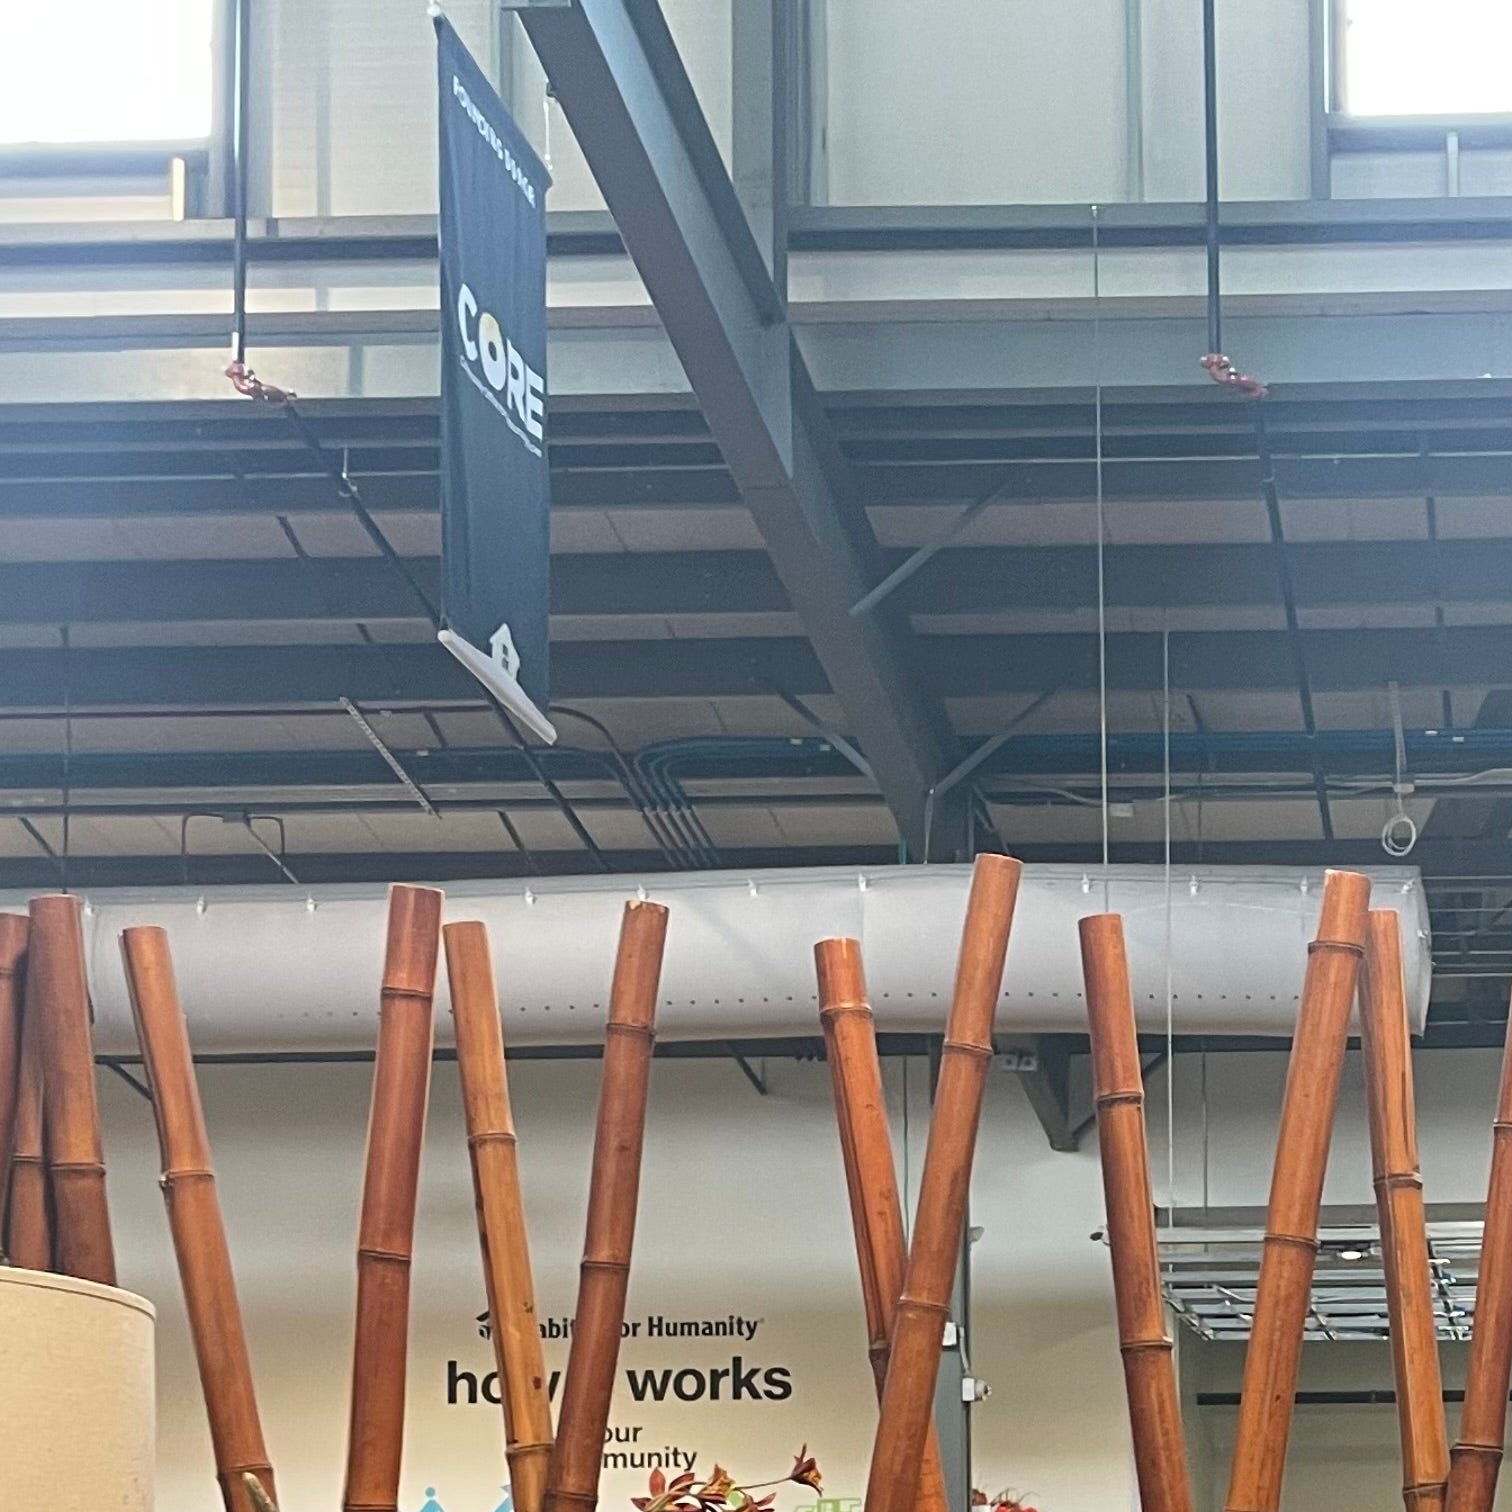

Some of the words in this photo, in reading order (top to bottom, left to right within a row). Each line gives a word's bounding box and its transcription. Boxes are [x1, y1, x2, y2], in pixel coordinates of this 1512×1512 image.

[458, 283, 545, 443] CORE
[620, 1321, 642, 1338] or
[648, 1315, 758, 1341] Humanity
[627, 1356, 793, 1402] works
[603, 1446, 698, 1473] munity
